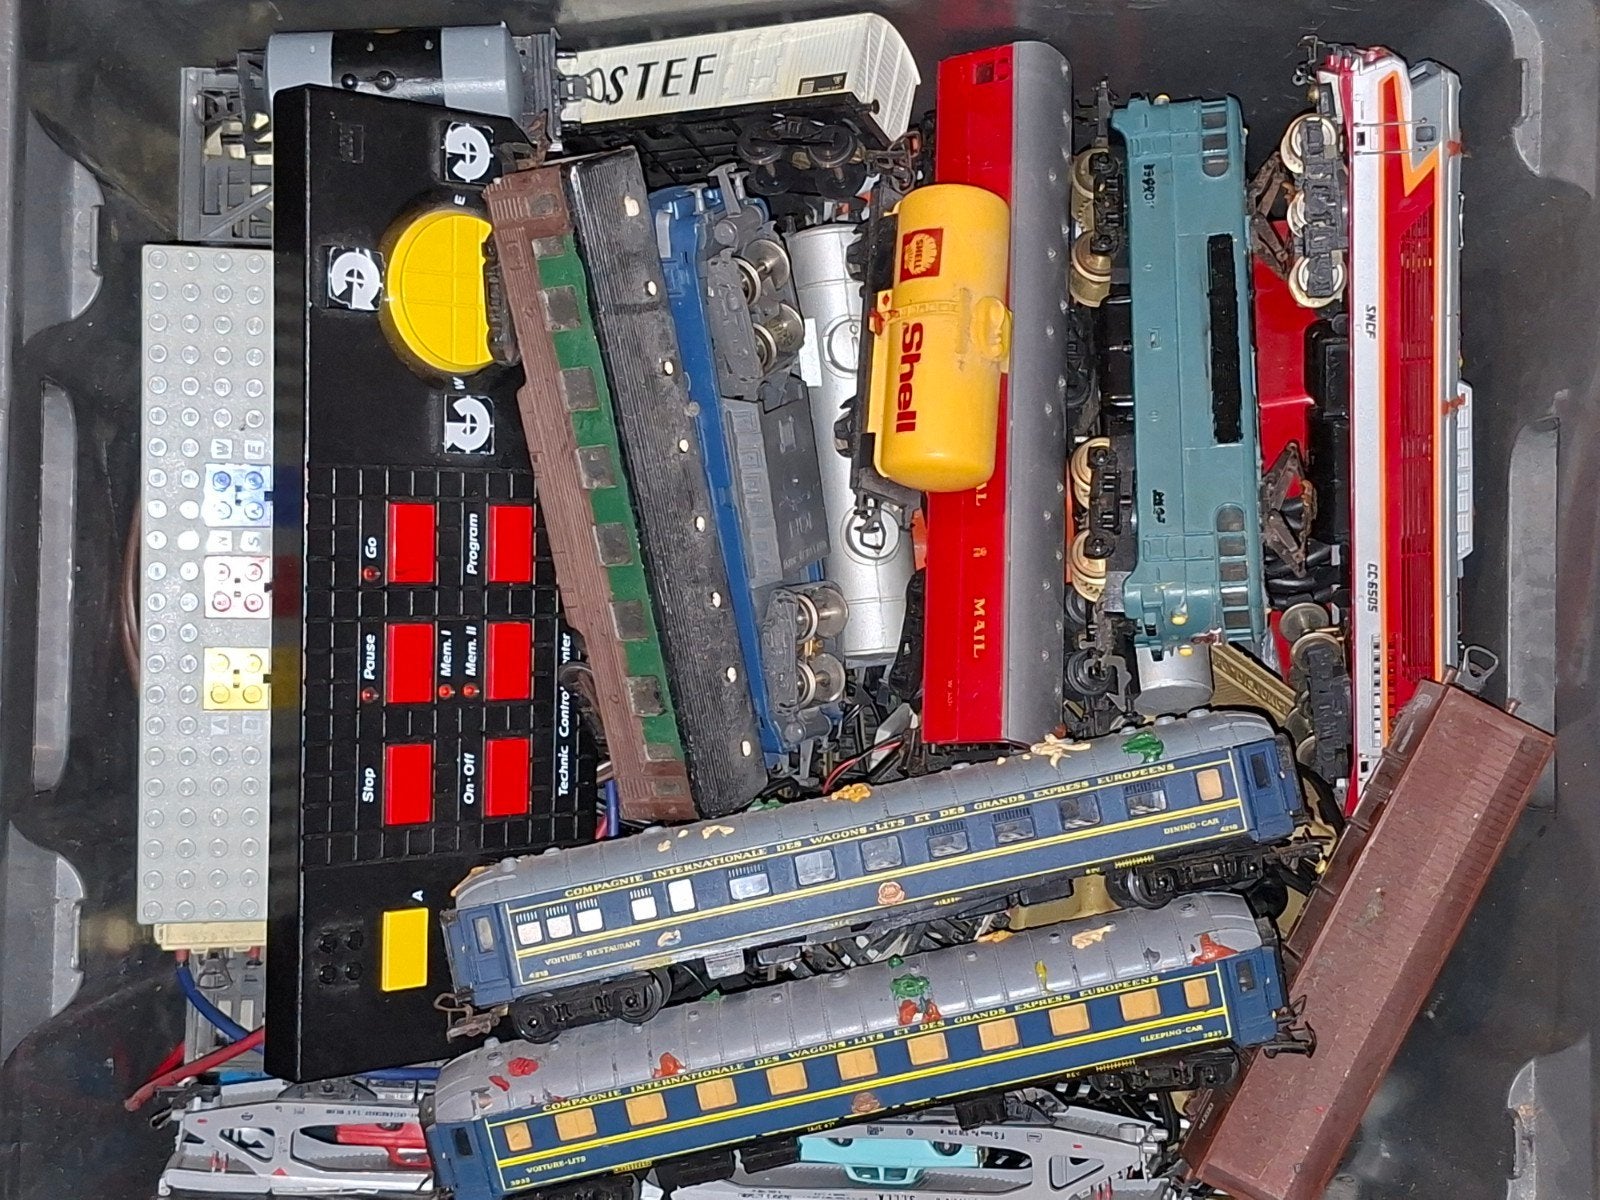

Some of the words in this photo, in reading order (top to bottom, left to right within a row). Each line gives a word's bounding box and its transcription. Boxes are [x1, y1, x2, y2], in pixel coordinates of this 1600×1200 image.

[608, 52, 717, 103] STEF
[455, 195, 465, 206] E
[914, 239, 925, 270] SHELL
[1367, 304, 1377, 339] SNCF
[454, 378, 465, 390] W
[897, 322, 925, 433] Shell
[216, 441, 229, 455] W
[248, 444, 261, 455] E
[364, 537, 378, 559] Go
[466, 513, 479, 575] Program
[465, 626, 477, 637] II
[973, 598, 986, 658] MAIL
[363, 634, 376, 680] Pause
[441, 639, 452, 677] Mem.
[465, 639, 477, 676] Mem.
[362, 767, 375, 803] Stop
[557, 746, 570, 796] Technic
[564, 875, 644, 898] COMPAGNIE
[651, 847, 767, 878] INTERNATIONALE
[776, 839, 802, 853] DES
[914, 812, 931, 823] ET
[939, 805, 966, 818] DES
[973, 792, 1026, 810] GRANDS
[1033, 780, 1090, 799] EXPRESS
[1097, 763, 1176, 784] EUROPEENS
[412, 890, 423, 903] A
[542, 1089, 622, 1113] COMPAGNIE
[629, 1062, 746, 1094] INTERNATIONALE
[754, 1054, 780, 1067] DES
[893, 1026, 910, 1037] ET
[919, 1019, 945, 1032] DES
[953, 1007, 1007, 1024] GRANDS
[1014, 993, 1071, 1011] EXPRESS
[1079, 975, 1160, 997] EUROPEENS
